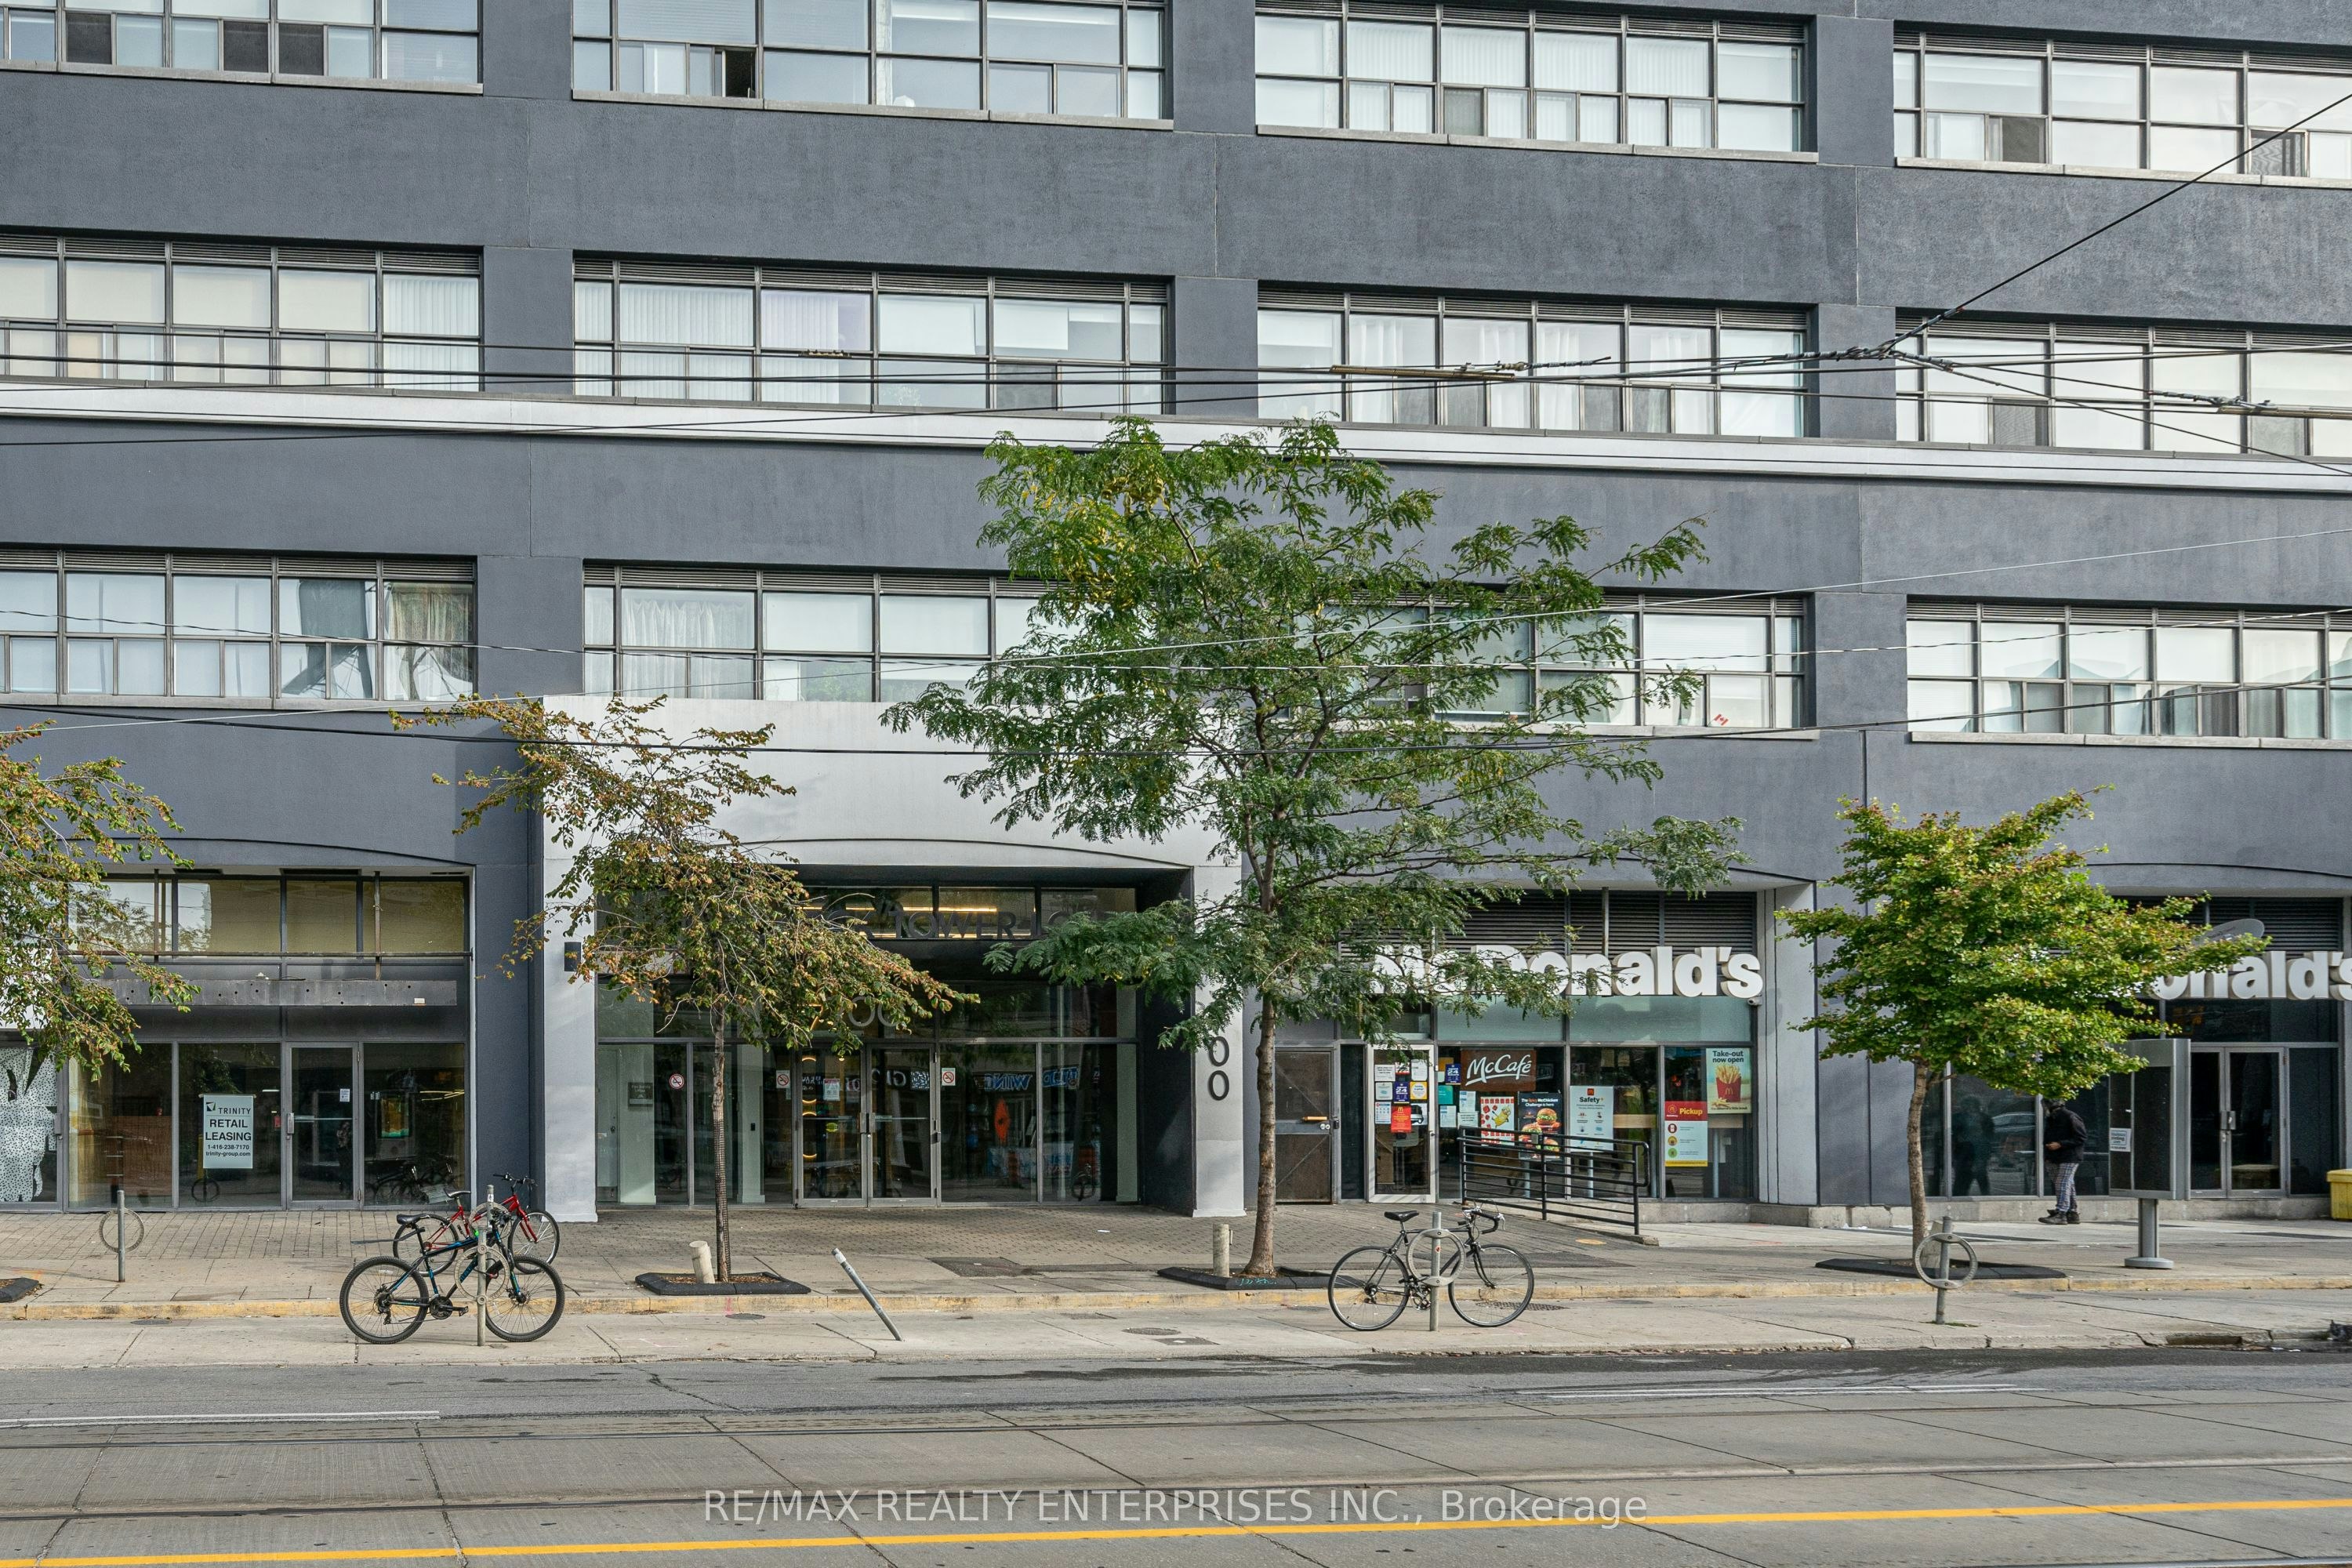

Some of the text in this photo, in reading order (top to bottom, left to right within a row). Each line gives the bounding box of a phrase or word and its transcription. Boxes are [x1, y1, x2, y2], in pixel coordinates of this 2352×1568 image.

[888, 910, 1016, 939] TOWER
[827, 995, 905, 1028] 00
[1208, 1035, 1230, 1101] 00
[1465, 1054, 1533, 1086] McCafé
[209, 1119, 248, 1128] RETAIL
[1679, 1107, 1703, 1116] Pickup
[205, 1131, 251, 1141] LEASING
